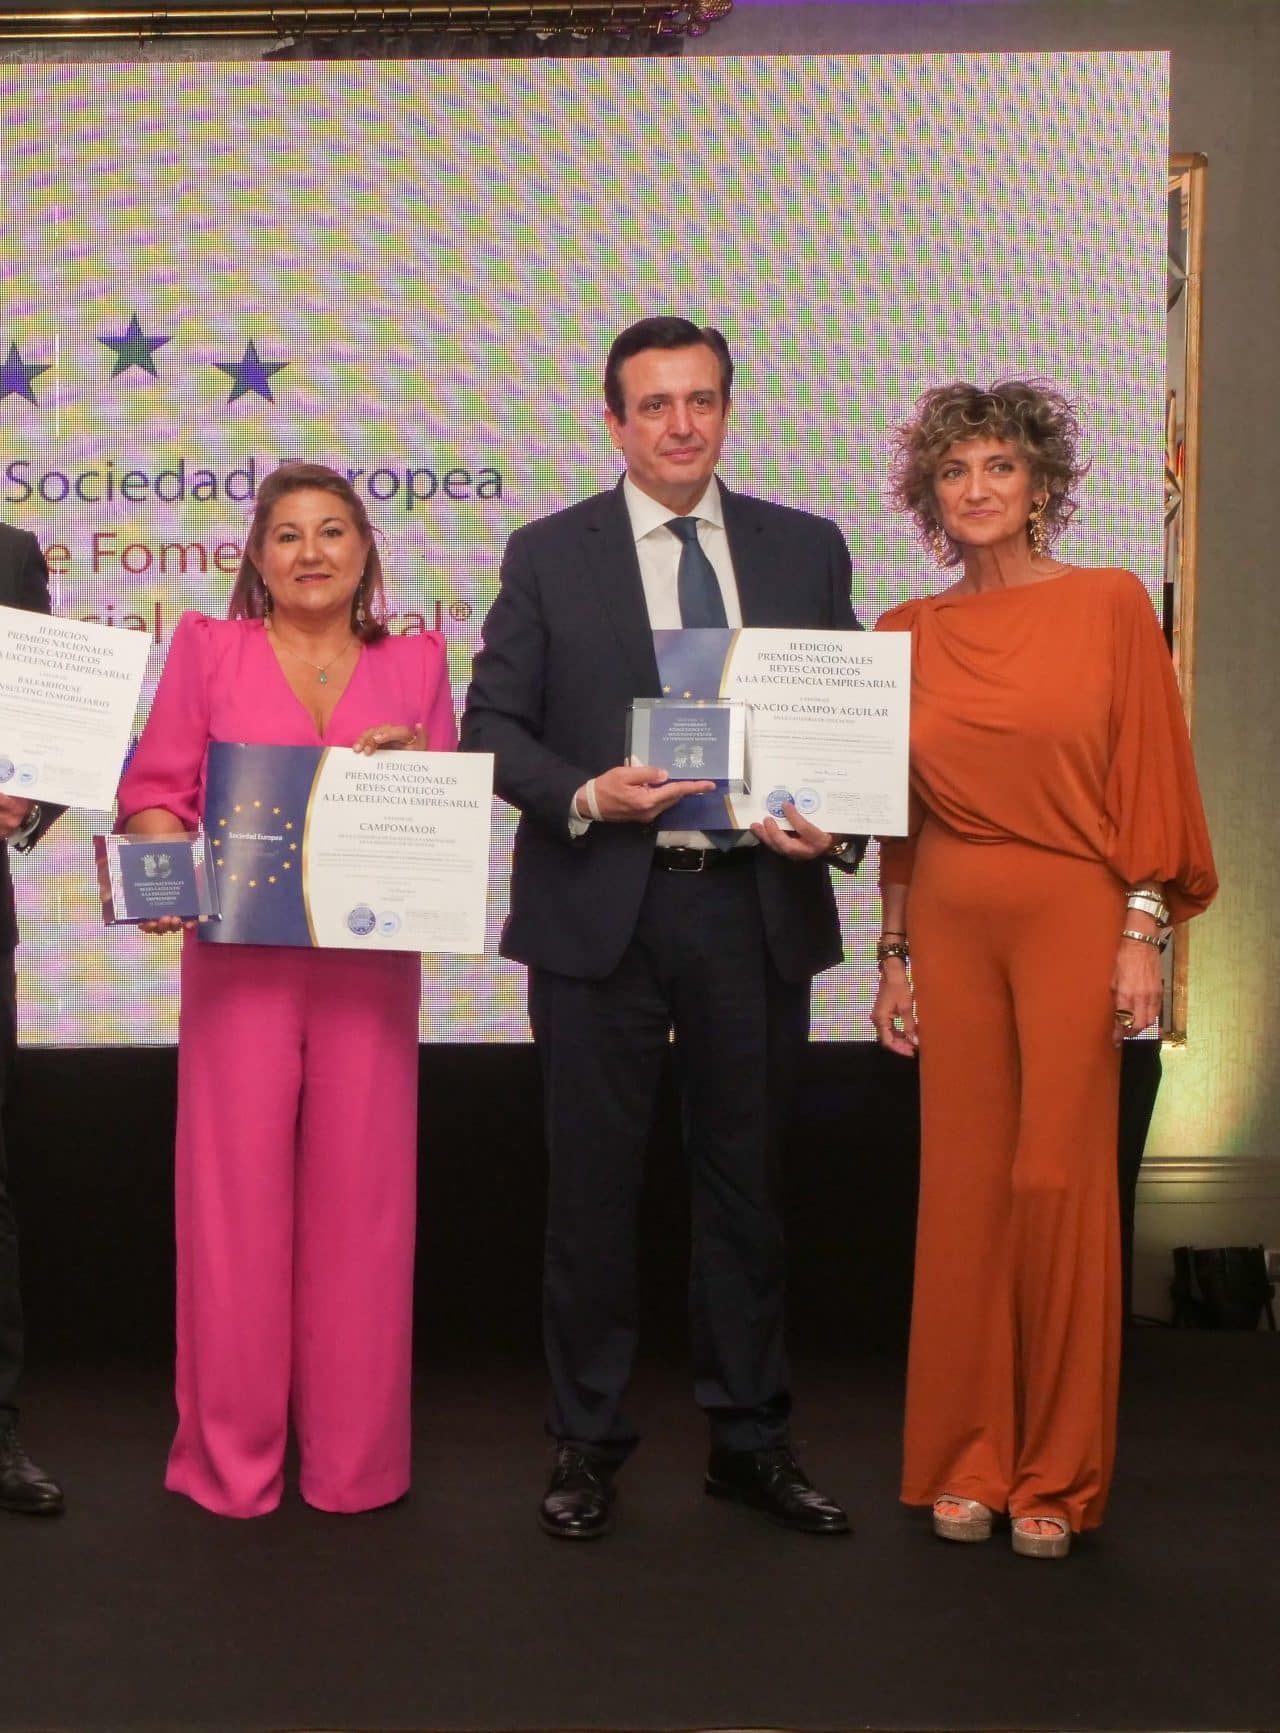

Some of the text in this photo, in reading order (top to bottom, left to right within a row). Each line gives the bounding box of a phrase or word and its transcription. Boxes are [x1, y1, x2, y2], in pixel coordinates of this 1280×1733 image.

[5, 457, 504, 511] Sociedad ropea
[45, 532, 241, 575] e Fome
[7, 631, 114, 657] PREMIOS NACIONALES
[16, 644, 44, 655] REYES
[790, 642, 797, 651] II
[5, 651, 63, 669] EXCELENCIA
[65, 663, 132, 680] EMPRESARIAL
[758, 653, 873, 665] PREMIOS NACIONALES
[769, 664, 800, 674] REYES
[736, 675, 897, 688] A LA EXCELENCIA EMPRESARIAL
[752, 703, 889, 717] NACIO CAMPOY AGUILAR
[377, 762, 384, 770] II
[345, 771, 457, 785] PREMIOS NACIONALES
[356, 783, 386, 793] REYES
[322, 793, 479, 809] A LA EXCELENCIA EMPRESARIAL
[359, 822, 438, 835] CAMPOMAYOR
